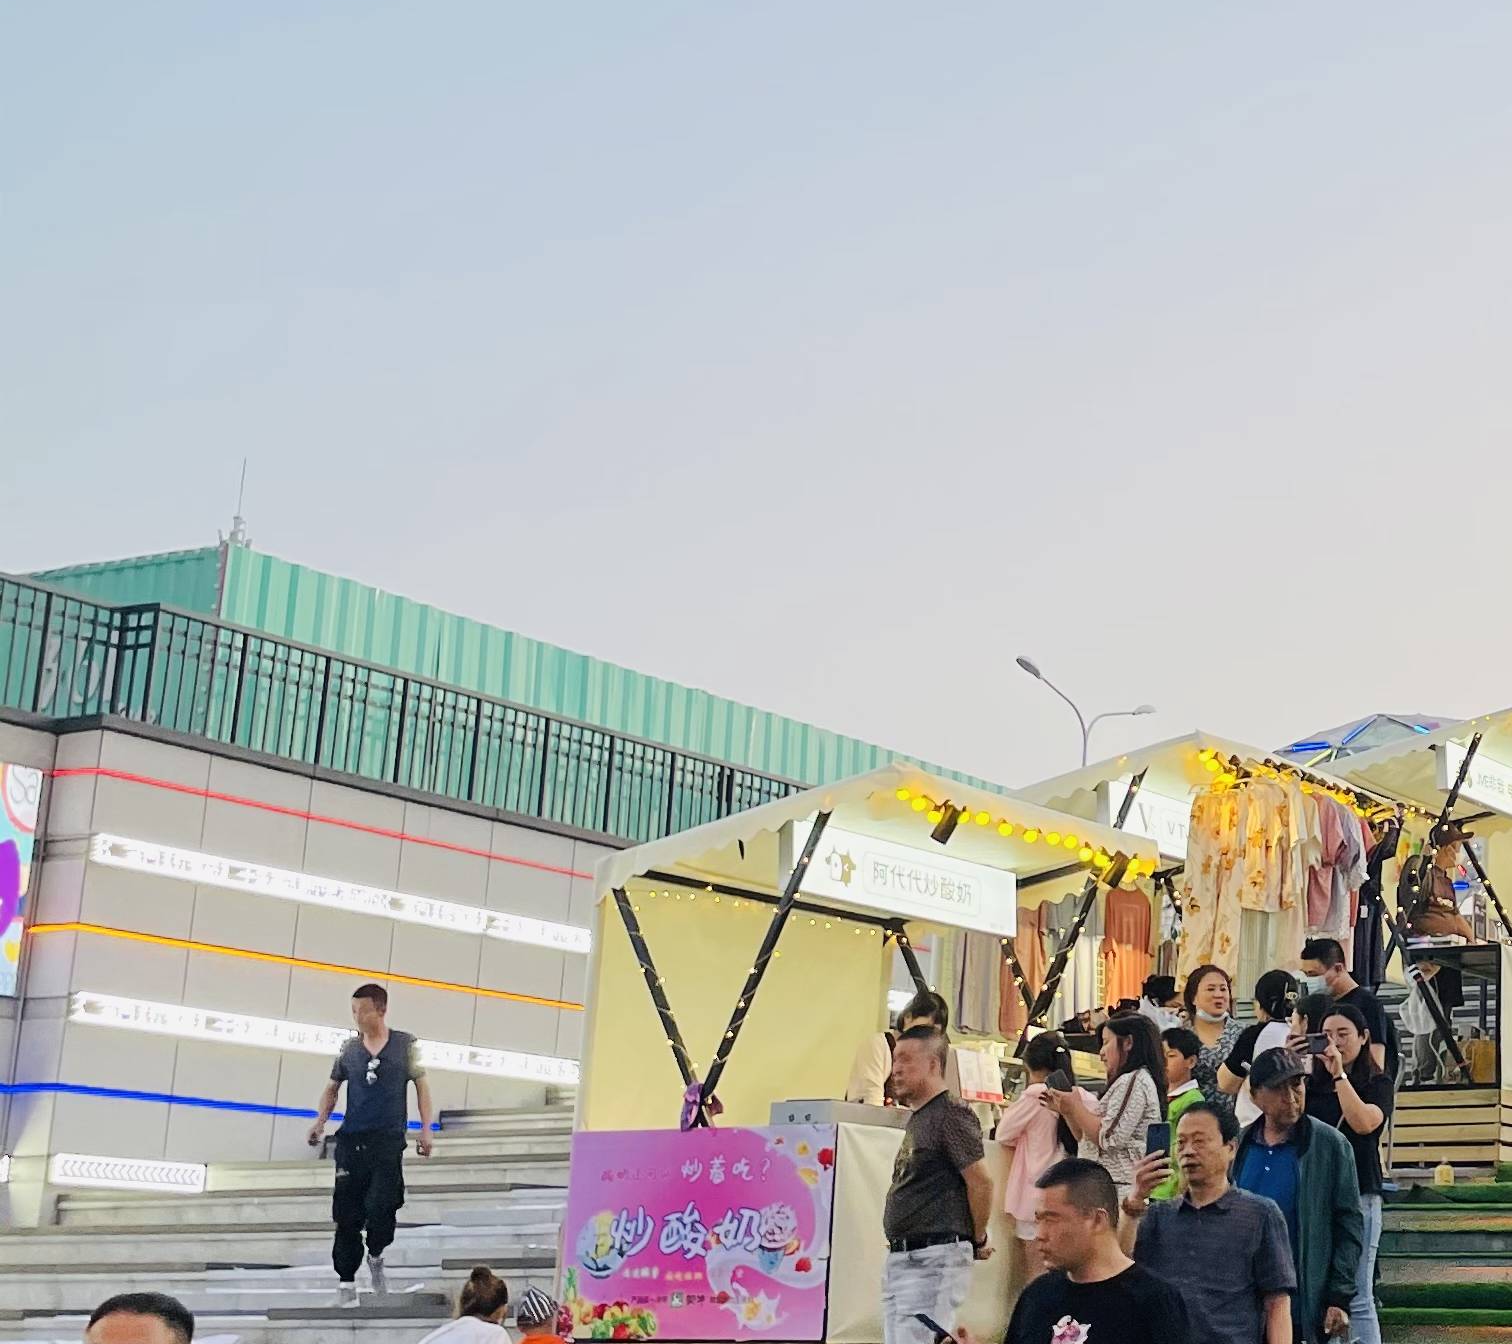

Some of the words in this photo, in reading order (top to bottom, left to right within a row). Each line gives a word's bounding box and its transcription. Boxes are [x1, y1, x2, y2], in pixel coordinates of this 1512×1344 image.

[872, 860, 972, 905] 阿代代炒酸奶
[611, 1201, 763, 1260] 炒酸奶
